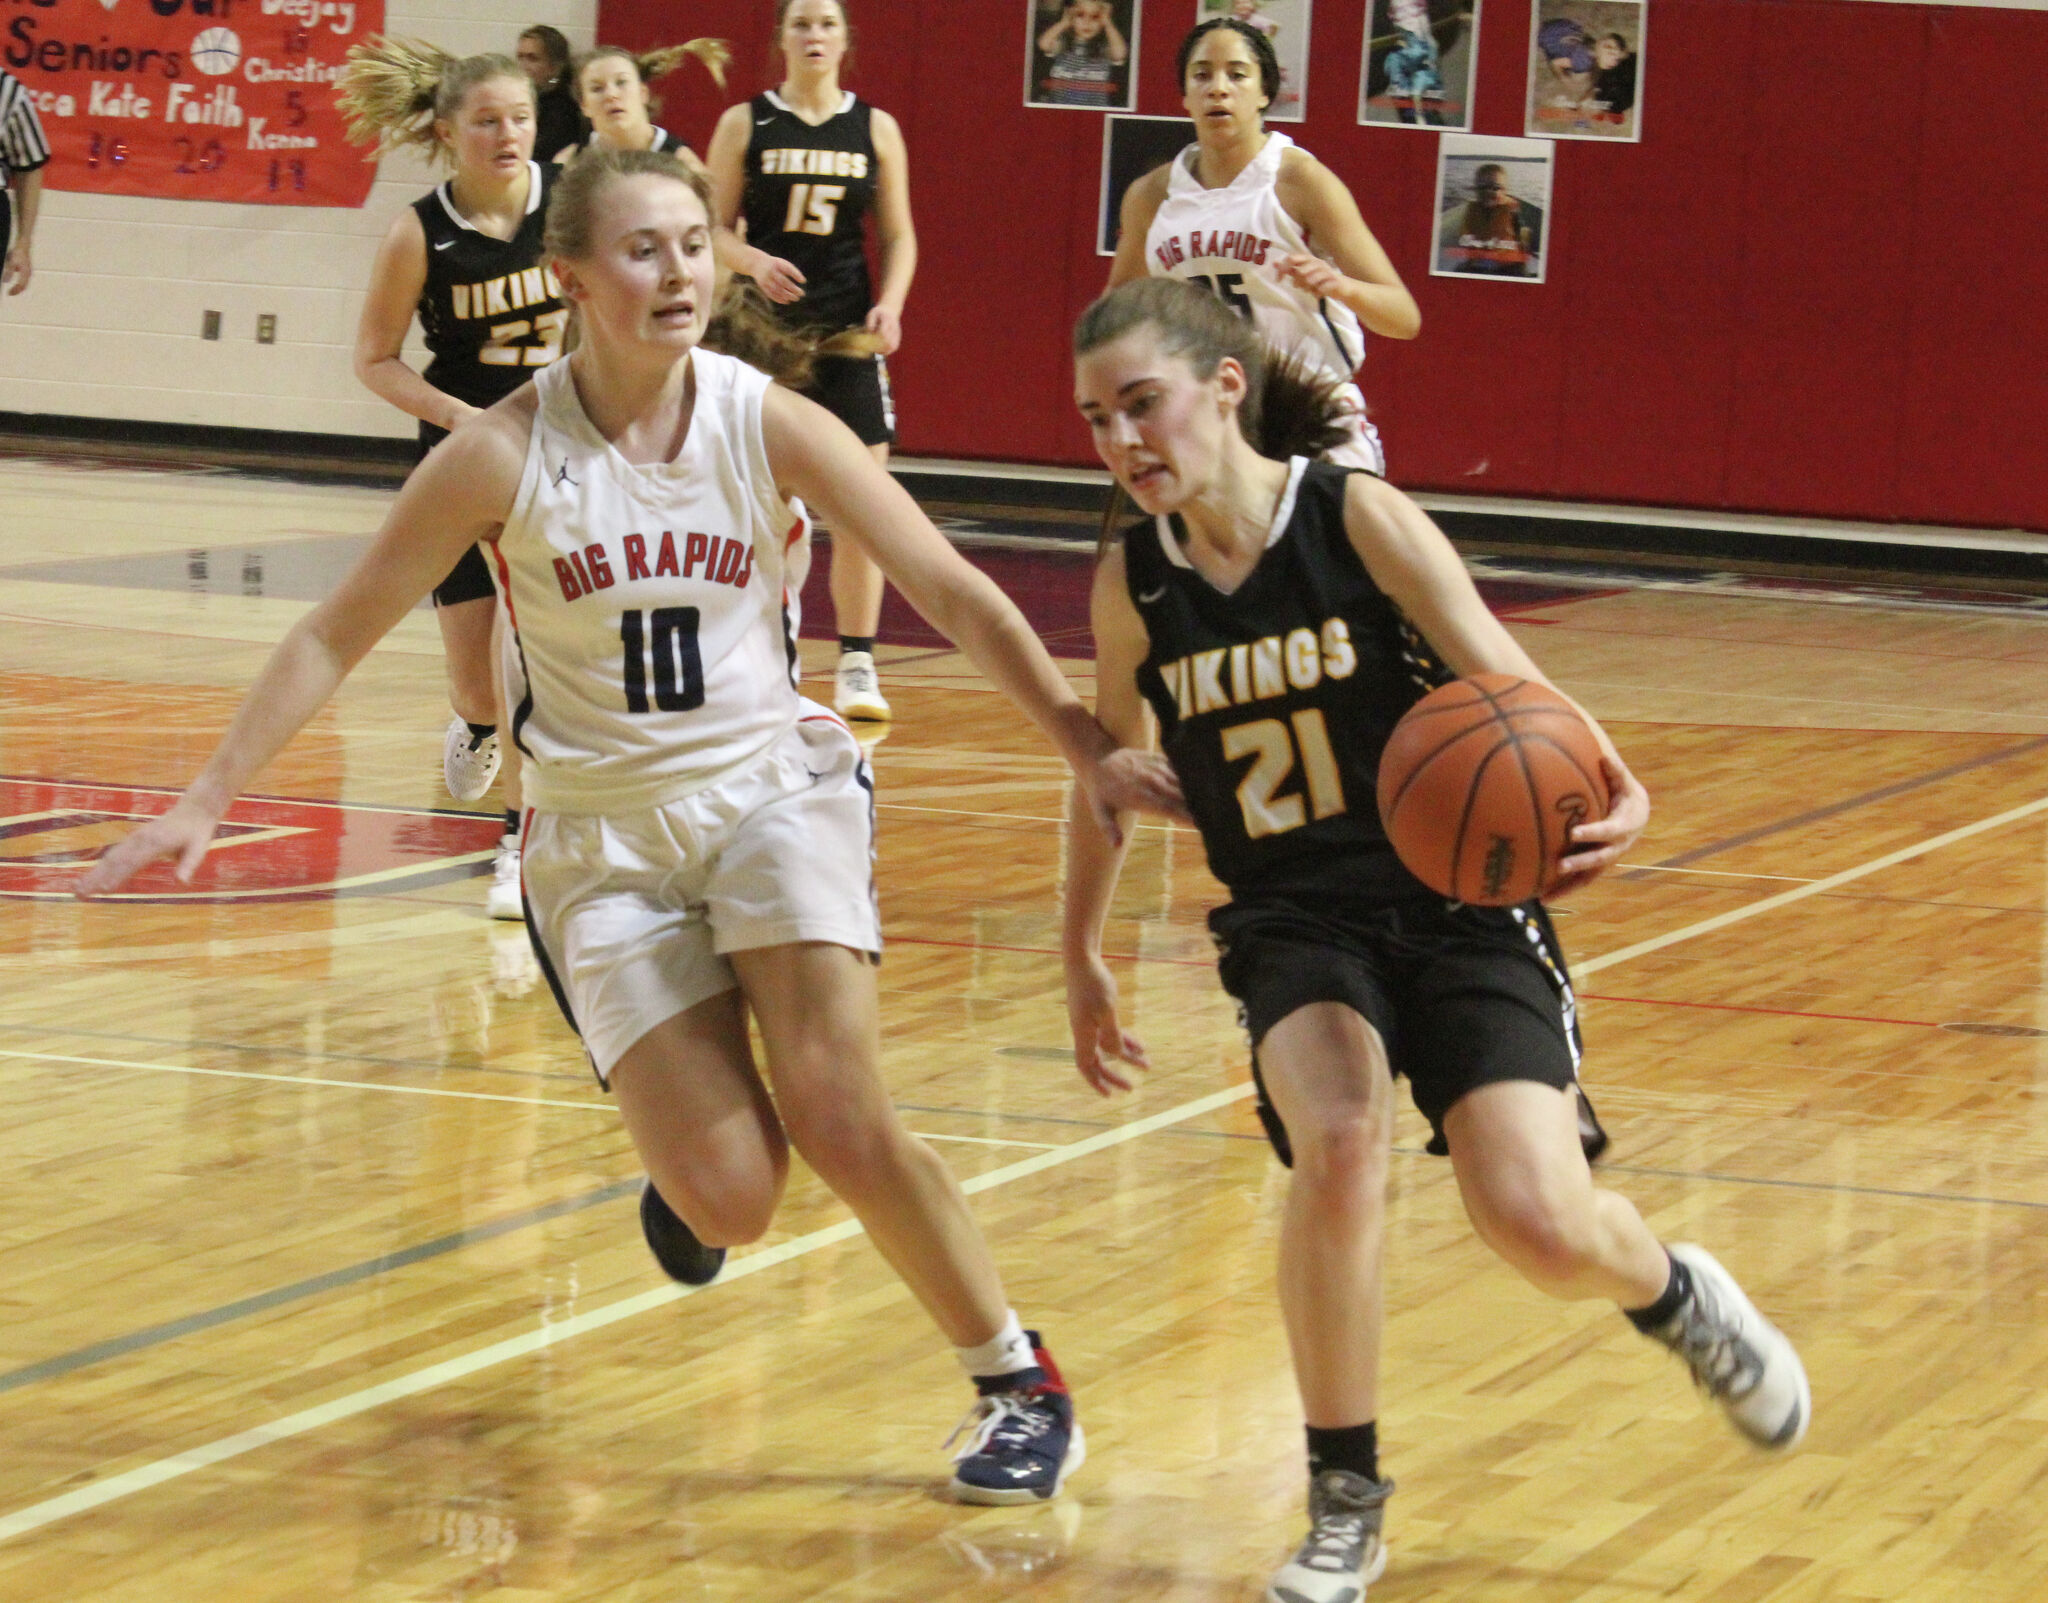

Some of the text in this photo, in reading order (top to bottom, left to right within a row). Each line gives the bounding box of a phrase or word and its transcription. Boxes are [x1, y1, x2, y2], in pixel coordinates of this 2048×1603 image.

[6, 15, 183, 79] Seniors
[88, 80, 152, 118] Kate
[165, 83, 244, 127] Faith
[783, 183, 847, 236] 15
[1190, 229, 1272, 266] RAPIDS
[451, 265, 561, 320] VIKIN
[1187, 272, 1254, 322] 5
[478, 308, 570, 367] 23
[552, 531, 754, 602] BIG RAPIDS
[621, 606, 705, 713] 10
[1159, 616, 1358, 721] VIKINGS
[1220, 707, 1347, 839] 21
